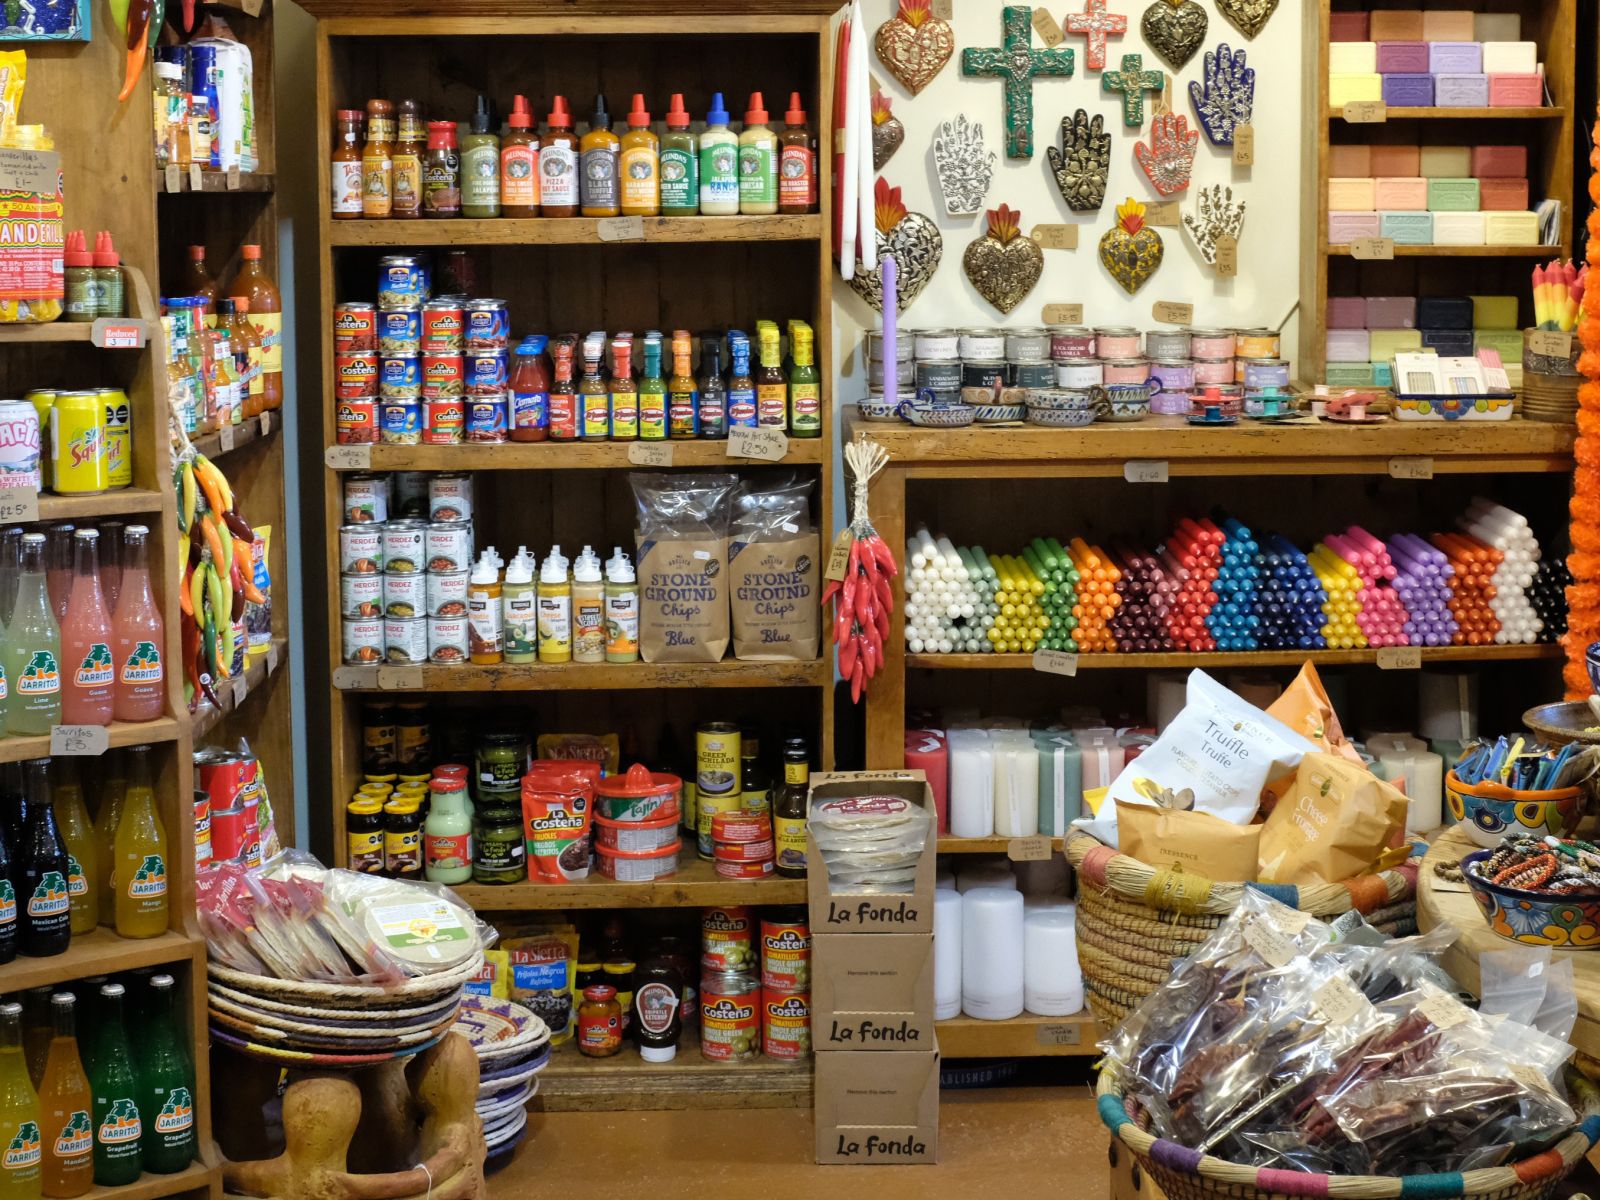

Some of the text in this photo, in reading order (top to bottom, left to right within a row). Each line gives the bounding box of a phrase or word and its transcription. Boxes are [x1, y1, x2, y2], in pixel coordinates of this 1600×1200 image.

[710, 182, 738, 191] RANCH
[343, 314, 352, 322] La
[106, 330, 138, 338] Reduced
[354, 362, 364, 370] La
[342, 368, 376, 377] Costeña
[350, 536, 376, 544] HERDEZ
[651, 573, 711, 587] STONE
[744, 571, 803, 586] STONE
[645, 588, 717, 602] GROUND
[736, 585, 811, 602] GROUND
[660, 602, 701, 621] Chips
[754, 601, 796, 620] Chips
[665, 630, 696, 646] Blue
[760, 629, 793, 644] Blue
[79, 672, 114, 682] JARRITOS
[124, 668, 160, 680] JARRITOS
[21, 680, 58, 690] JARRITOS
[55, 727, 92, 738] Jarritos
[65, 740, 87, 752] £3
[1203, 720, 1250, 760] Truffle
[1200, 740, 1232, 769] Truffe
[824, 772, 850, 780] La
[552, 810, 564, 818] La
[1298, 796, 1328, 826] Cheese
[533, 818, 582, 829] Costeña
[132, 882, 166, 894] JARRITOS
[32, 900, 69, 911] JARRITOS
[714, 912, 724, 921] La
[827, 902, 851, 924] La
[32, 918, 58, 926] Mexican
[784, 932, 795, 941] La
[515, 944, 566, 964] La Sierra
[539, 966, 566, 978] Negros
[720, 1002, 730, 1010] La
[788, 1000, 799, 1008] La
[704, 1008, 750, 1019] Costeña
[830, 1020, 853, 1042] La
[941, 1071, 993, 1085] ABLISHED
[160, 1114, 192, 1128] JARRITOS
[102, 1126, 140, 1139] JARRITOS
[58, 1138, 92, 1152] JARRITOS
[106, 1142, 138, 1153] Grapefruit
[836, 1134, 860, 1156] La
[7, 1150, 41, 1164] JARRITOS
